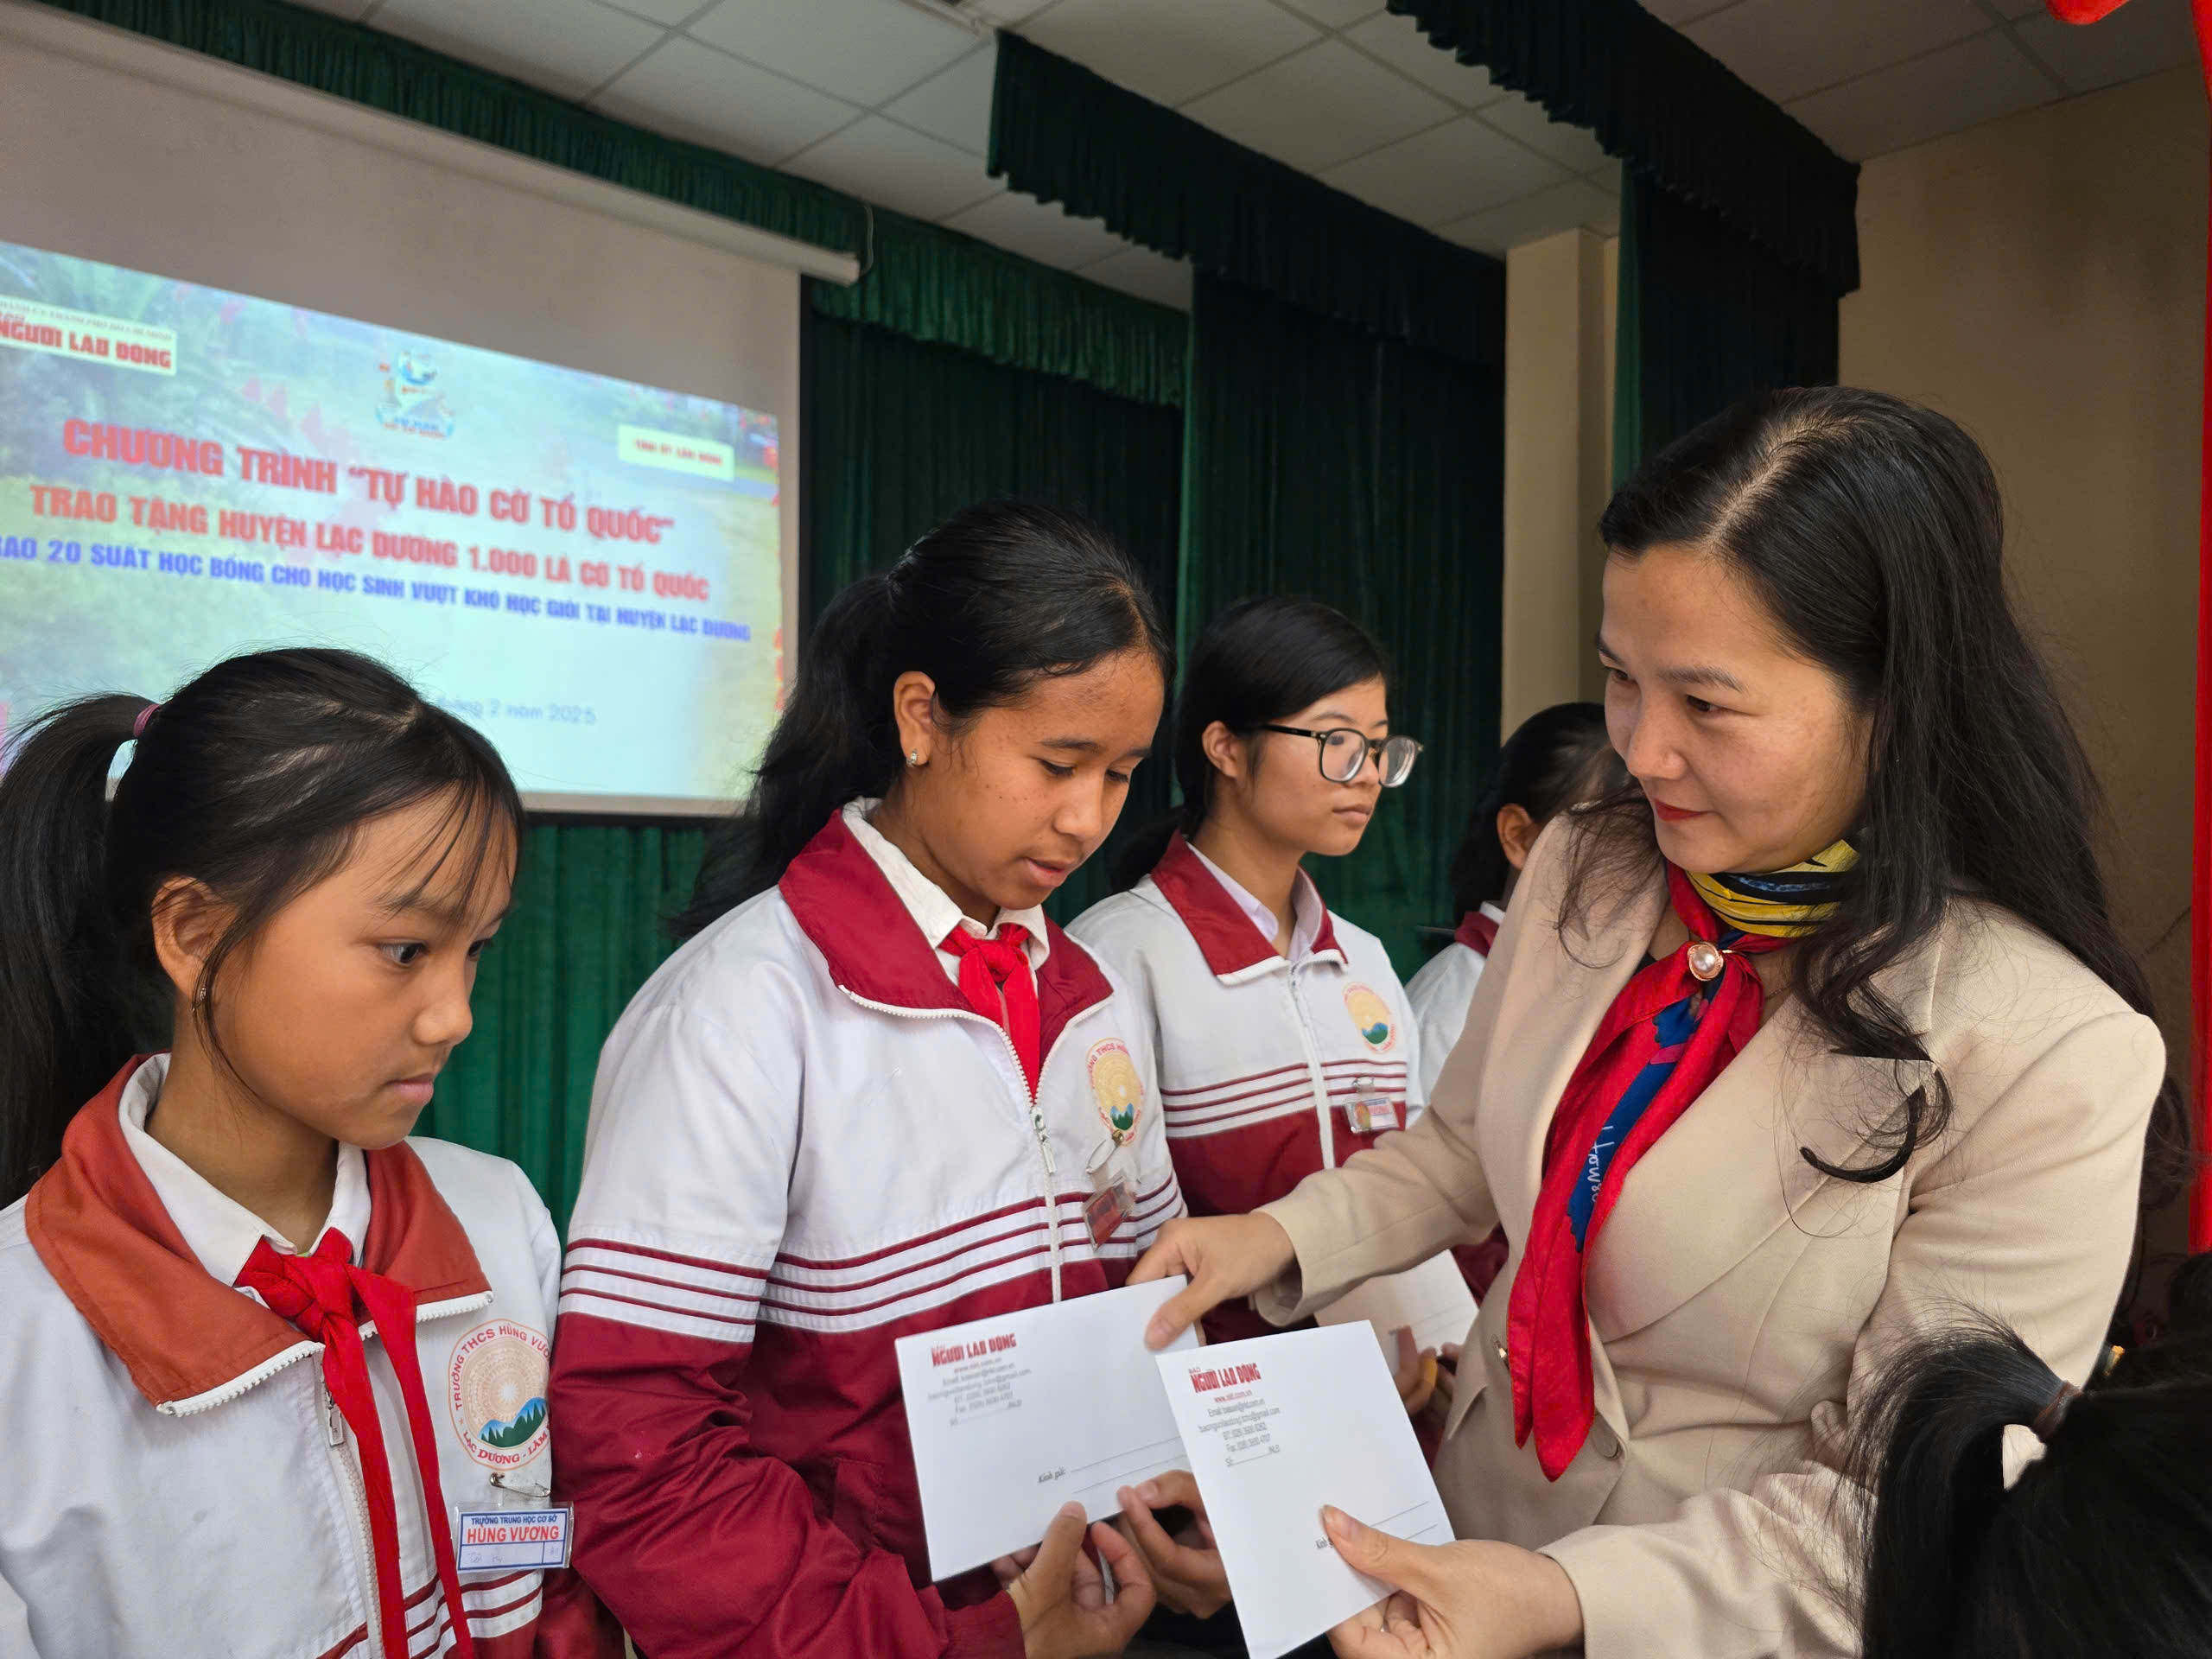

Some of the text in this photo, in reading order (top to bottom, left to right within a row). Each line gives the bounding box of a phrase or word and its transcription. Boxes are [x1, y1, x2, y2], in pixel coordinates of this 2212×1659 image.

[69, 331, 110, 357] LAO
[63, 418, 224, 477] CHƯƠNG
[236, 445, 337, 494] TRÌNH
[415, 474, 479, 516] HÀO
[489, 487, 531, 523] CỜ
[29, 484, 118, 524] TRAO
[129, 494, 209, 536] TẶNG
[219, 508, 308, 551] HUYỆN
[315, 522, 364, 558] LẠC
[372, 531, 459, 568] DƯƠNG
[468, 545, 537, 578] 1.000
[0, 535, 37, 560] AO
[48, 539, 81, 564] 20
[158, 551, 203, 576] HỌC
[271, 563, 311, 587] CHO
[317, 569, 357, 594] HỌC
[362, 575, 404, 598] SINH
[505, 593, 541, 616] HỌC
[549, 702, 596, 724] 2025
[966, 1341, 987, 1358] LAO
[451, 1323, 550, 1410] TRƯỜNG THCS HÙNG VƯƠ
[1217, 1367, 1237, 1388] LAO
[477, 1449, 520, 1464] DƯƠNG
[528, 1430, 548, 1455] LÂM
[467, 1522, 560, 1543] HÙNG VƯƠNG
[471, 1513, 558, 1526] TRƯỜNG TRUNG HỌC CƠ SỞ
